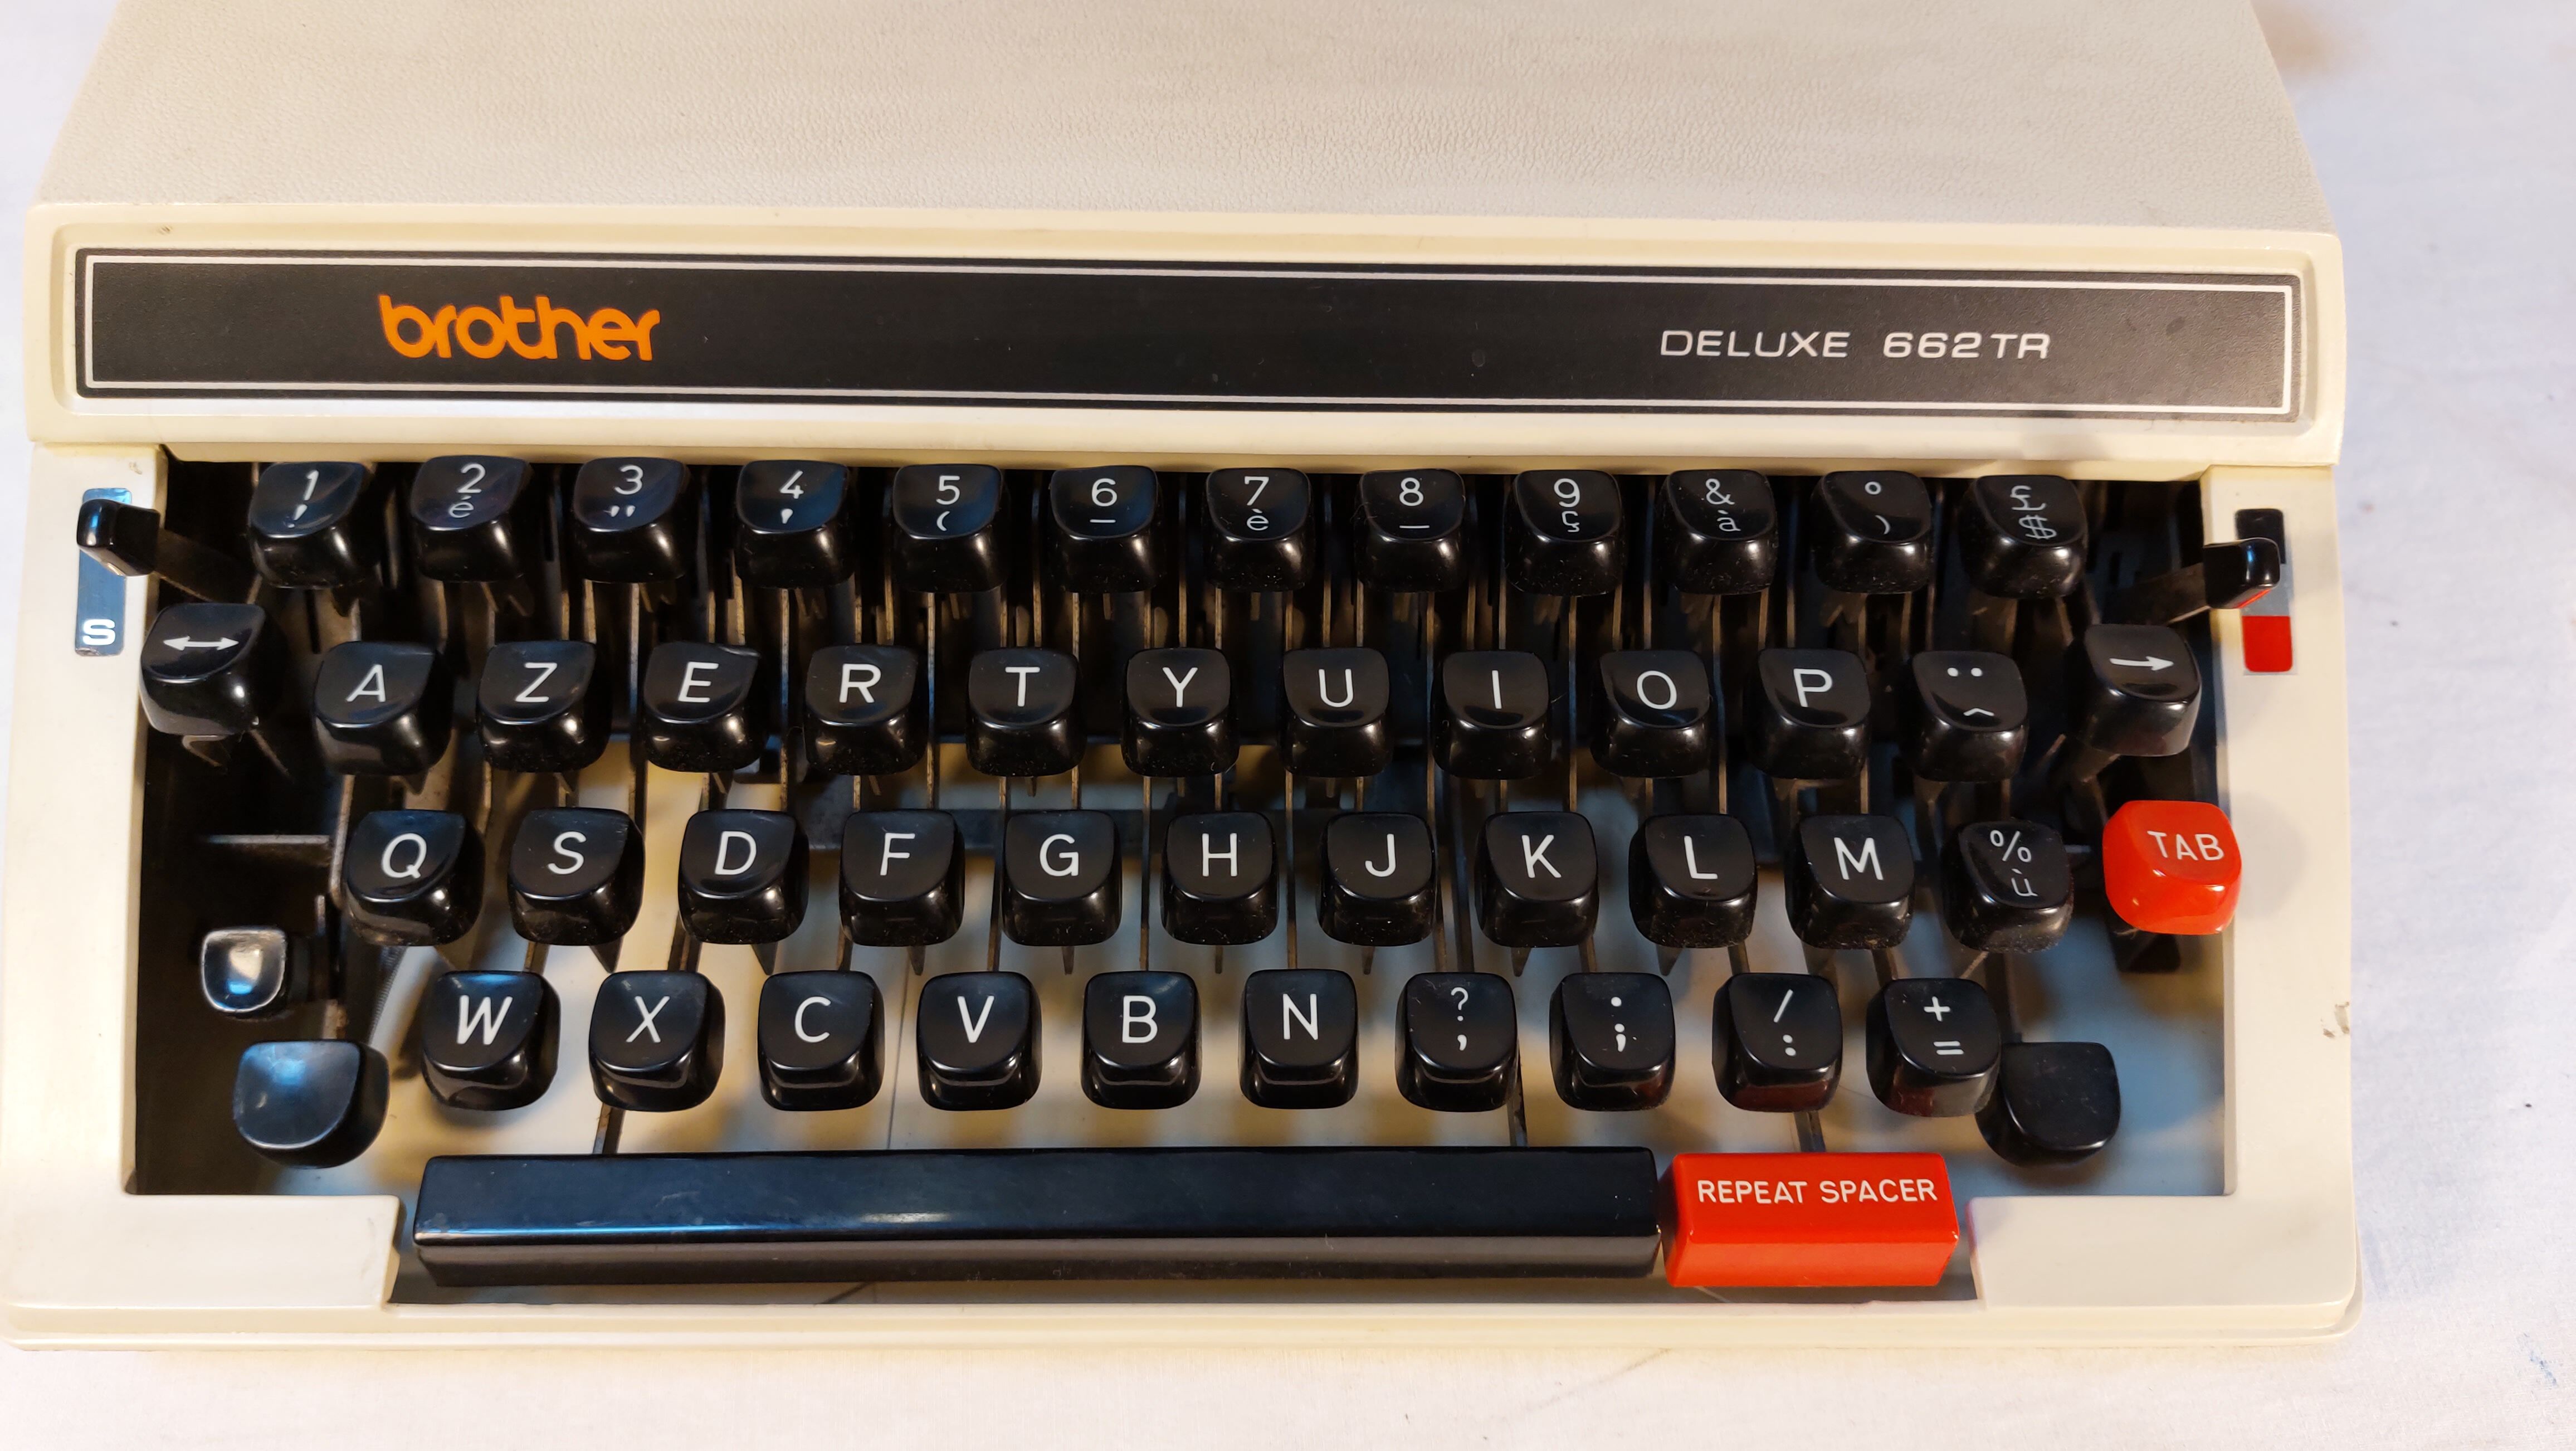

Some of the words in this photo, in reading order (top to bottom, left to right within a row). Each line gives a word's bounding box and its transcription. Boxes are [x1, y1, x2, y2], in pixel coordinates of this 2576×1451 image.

[378, 294, 660, 361] brother
[1660, 330, 1851, 358] DELUXE
[304, 470, 319, 501] 1
[457, 463, 485, 493] 2
[614, 465, 643, 495] 3
[779, 470, 804, 499] 4
[936, 475, 960, 505] 5
[1091, 478, 1118, 507] 6
[1244, 476, 1269, 506] 7
[1399, 477, 1424, 507] 8
[1554, 478, 1580, 508] 9
[1705, 478, 1735, 505] &
[448, 495, 474, 518] é
[1246, 508, 1269, 531] è
[1717, 510, 1741, 532] à
[2018, 514, 2057, 539] $
[82, 619, 116, 646] S
[346, 664, 386, 703] A
[515, 662, 558, 703] Z
[677, 661, 719, 703] E
[839, 663, 881, 703] R
[1005, 666, 1040, 707] T
[1162, 667, 1198, 708] Y
[1319, 669, 1354, 708] U
[1492, 670, 1502, 709] I
[1637, 670, 1677, 709] O
[1793, 668, 1832, 708] P
[381, 833, 427, 879] Q
[548, 831, 586, 875] S
[715, 831, 757, 875] D
[880, 832, 915, 876] F
[1040, 834, 1079, 877] G
[1202, 832, 1237, 877] H
[1365, 834, 1396, 877] J
[1521, 835, 1562, 878] K
[1684, 835, 1718, 879] L
[1834, 837, 1884, 880] M
[1990, 830, 2032, 863] %
[2146, 830, 2224, 861] TAB
[457, 995, 513, 1045] W
[626, 996, 670, 1043] X
[794, 996, 831, 1043] C
[957, 995, 994, 1043] V
[1122, 995, 1158, 1043] B
[1282, 994, 1319, 1040] N
[1451, 987, 1468, 1021] ?
[1773, 989, 1793, 1023] /
[1924, 996, 1950, 1021] +
[1933, 1041, 1964, 1055] =
[1697, 1180, 1808, 1204] REPEAT
[1819, 1179, 1938, 1204] SPACER
